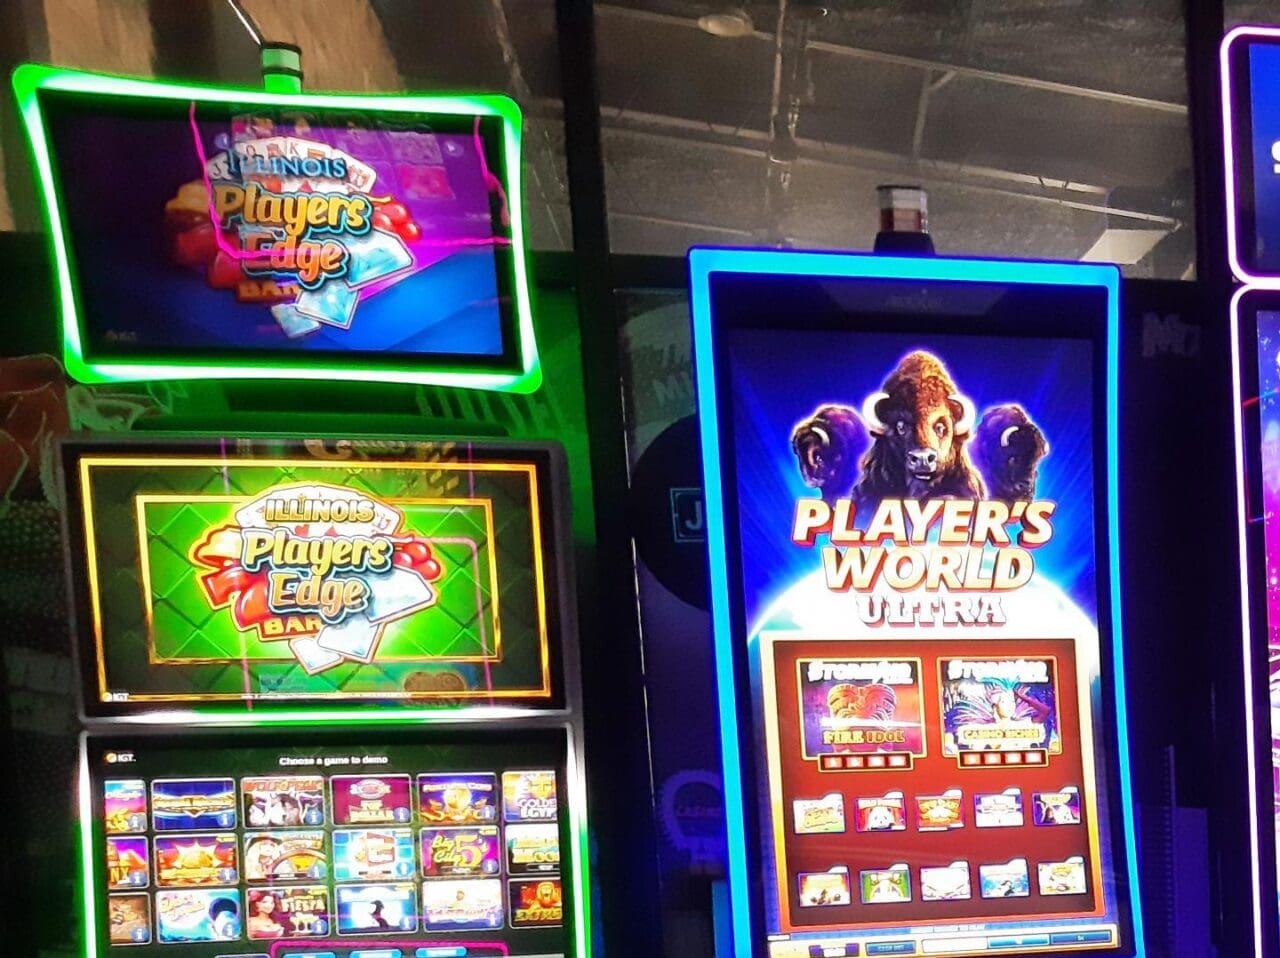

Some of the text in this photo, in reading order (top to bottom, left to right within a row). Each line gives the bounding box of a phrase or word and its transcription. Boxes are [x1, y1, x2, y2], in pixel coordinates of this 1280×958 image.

[229, 150, 347, 178] ILLINOIS
[214, 183, 370, 236] Players
[241, 231, 347, 285] Edge
[265, 499, 375, 523] ILLINOIS
[792, 498, 1056, 548] PLAYER'S
[244, 529, 391, 572] Players
[822, 546, 1035, 591] WORLD
[270, 575, 368, 617] Edge
[856, 596, 1007, 628] ULTRA
[263, 618, 322, 634] BAR
[867, 730, 906, 744] IDOL
[117, 753, 137, 763] IGT
[279, 757, 314, 765] Choose
[324, 757, 349, 766] game
[351, 756, 361, 764] to
[362, 755, 388, 764] demo
